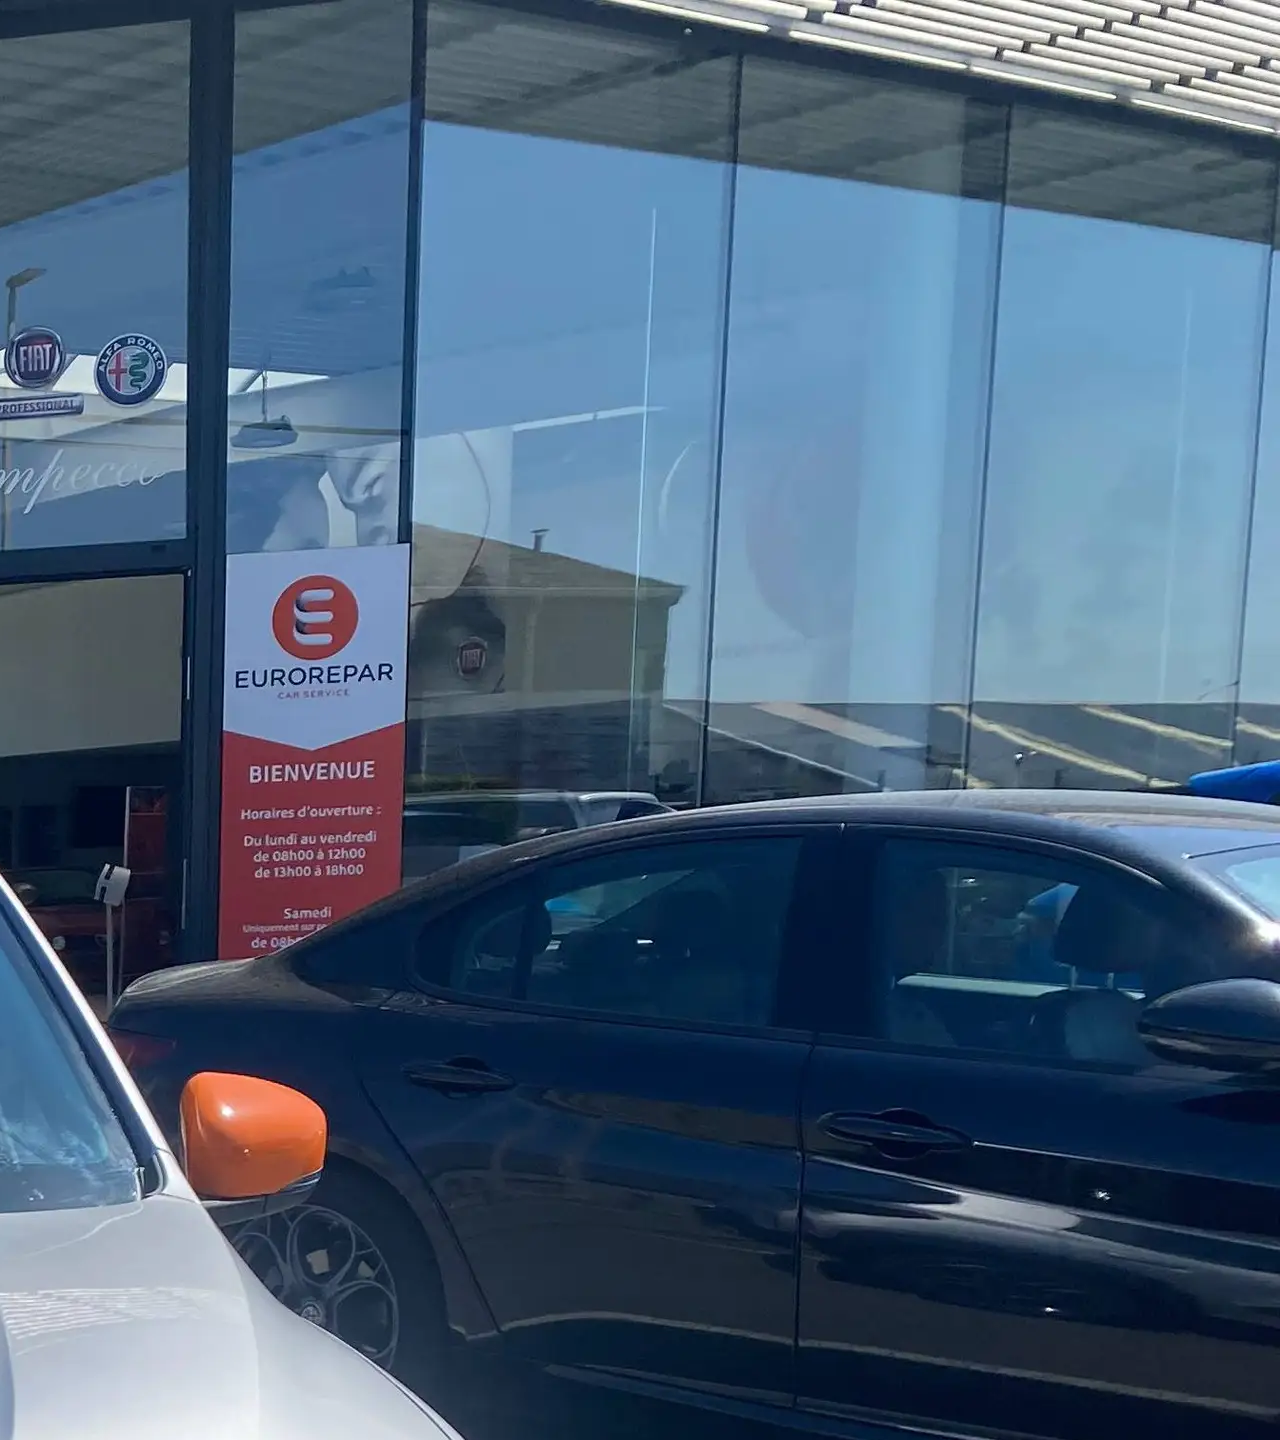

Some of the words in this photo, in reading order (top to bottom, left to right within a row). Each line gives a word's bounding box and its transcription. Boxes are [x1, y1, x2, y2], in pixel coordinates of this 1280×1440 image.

[19, 343, 53, 373] FIAT
[98, 342, 122, 373] ALFA
[127, 337, 164, 370] ROMEO
[235, 663, 393, 688] EUROREPAR
[277, 691, 300, 700] CAR
[303, 688, 351, 699] SERVICE
[249, 760, 375, 784] BIENVENUE
[240, 807, 295, 820] Horaires
[297, 804, 374, 818] d'ouverture
[244, 835, 262, 847] Du
[265, 832, 298, 846] lundi
[300, 835, 317, 845] au
[320, 830, 377, 844] vendredi
[253, 851, 269, 863] de
[272, 849, 314, 862] 08h00
[328, 847, 366, 860] 12h00
[254, 867, 270, 879] de
[274, 865, 311, 877] 13h00
[326, 863, 364, 876] 18h00
[283, 906, 332, 919] Samedi
[242, 923, 299, 934] Uniquement
[251, 936, 267, 949] de
